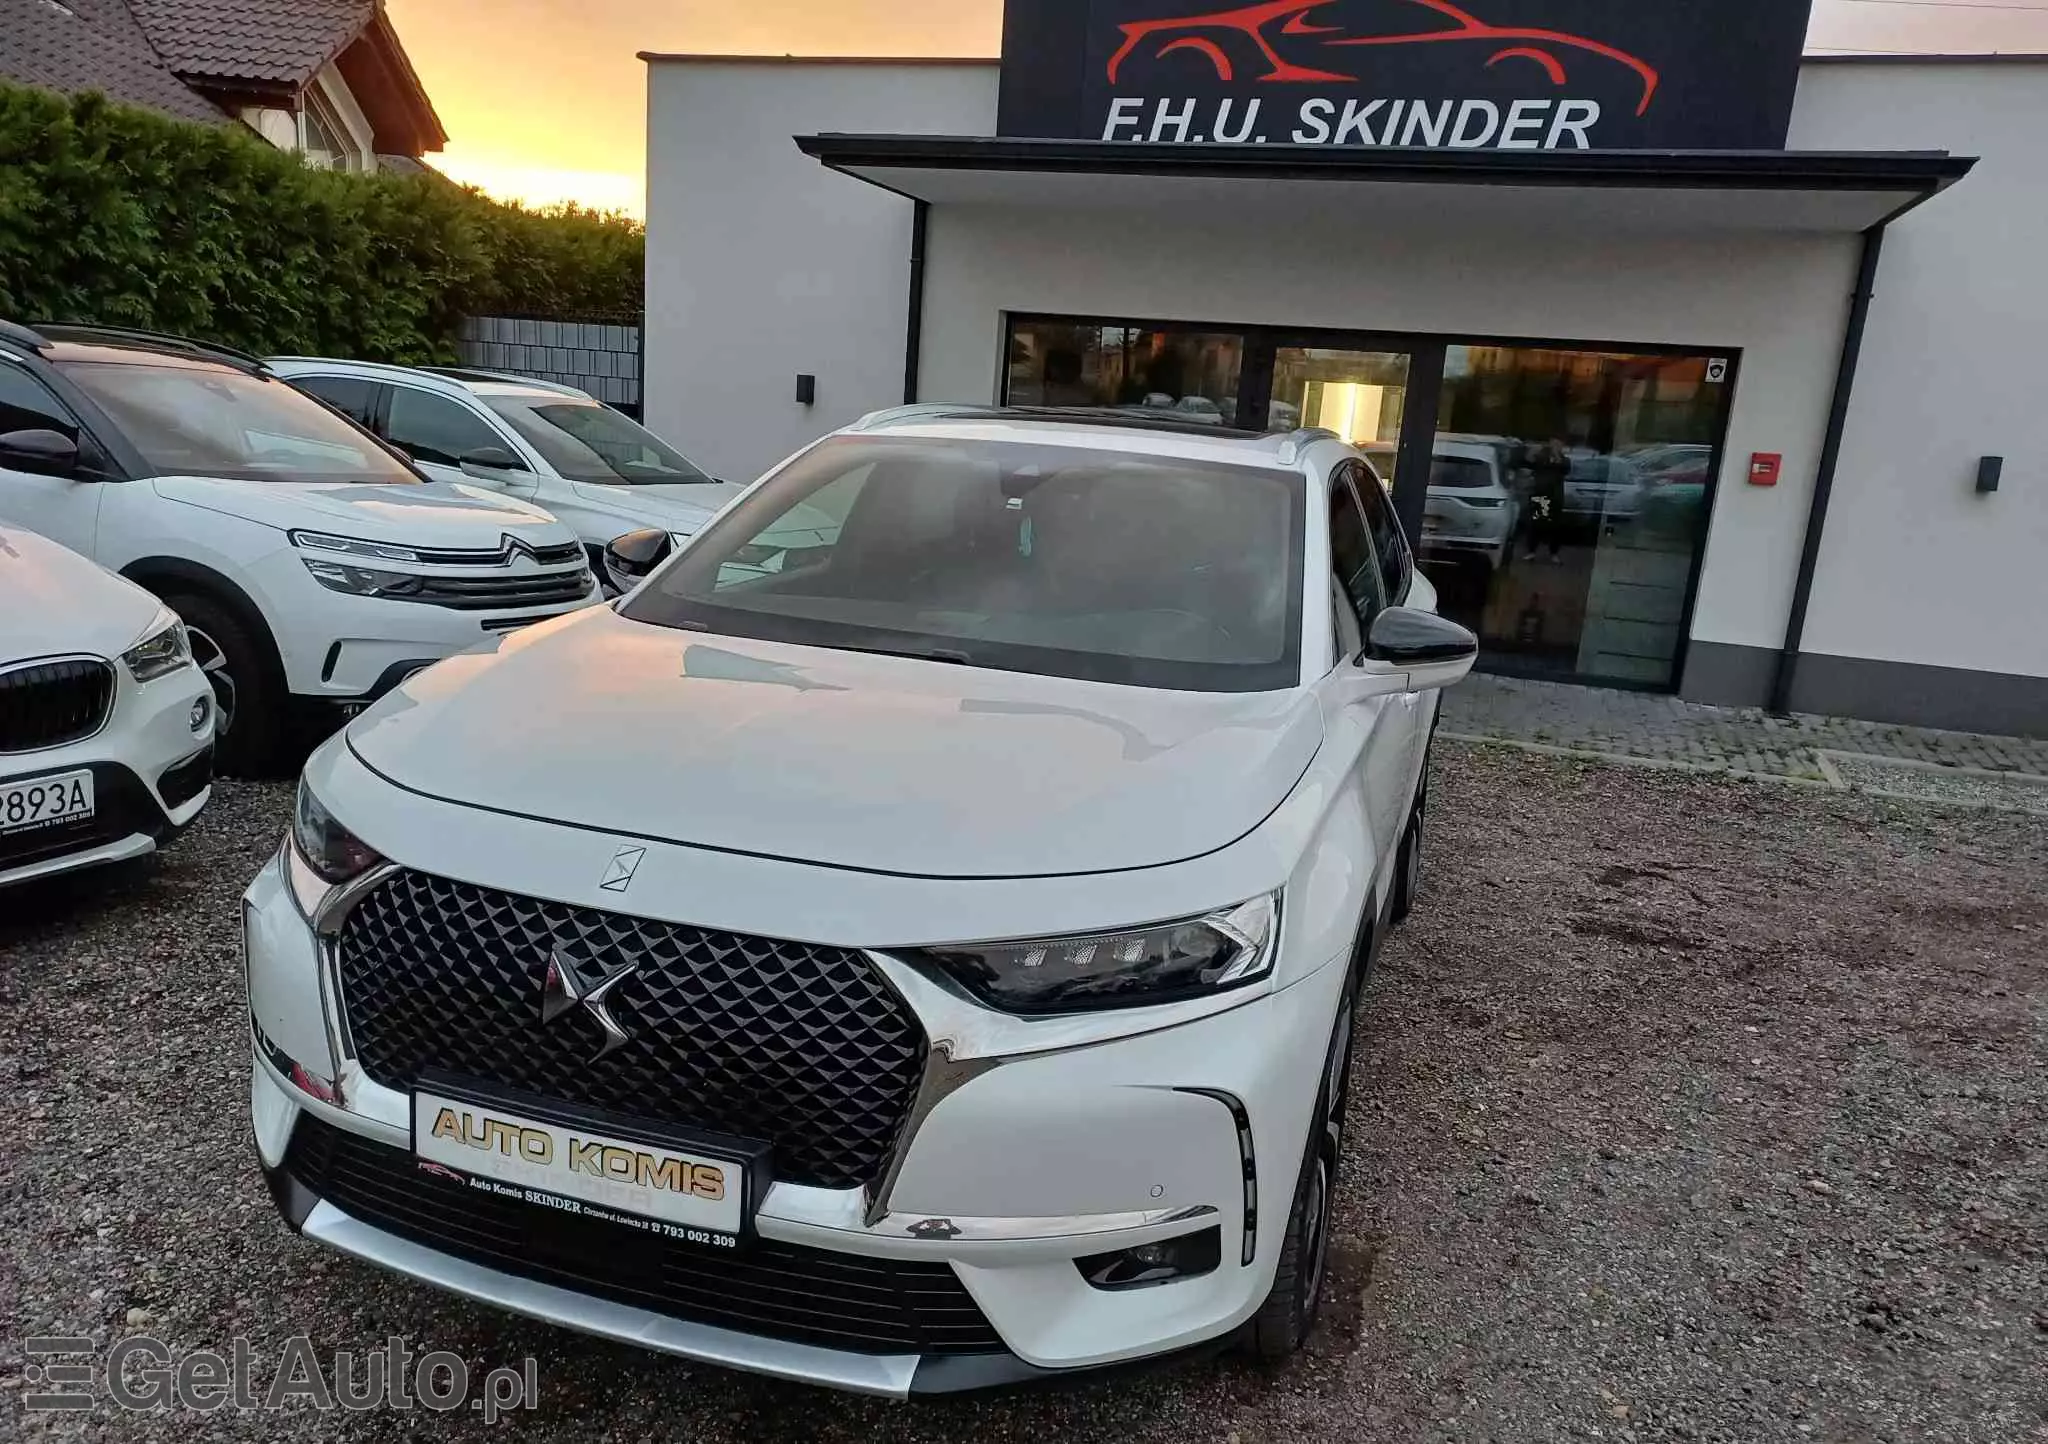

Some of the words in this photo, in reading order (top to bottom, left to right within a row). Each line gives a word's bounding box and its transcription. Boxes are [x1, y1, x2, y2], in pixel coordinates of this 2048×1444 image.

[1101, 97, 1267, 143] F.H.U.
[1291, 97, 1601, 150] SKINDER
[431, 1106, 554, 1166] AUTO
[568, 1136, 726, 1201] KOMIS
[469, 1177, 491, 1191] Auto
[493, 1183, 523, 1198] Komis
[525, 1190, 582, 1214] SKINDER
[663, 1224, 685, 1239] 793
[687, 1230, 710, 1244] 002
[713, 1235, 736, 1248] 309
